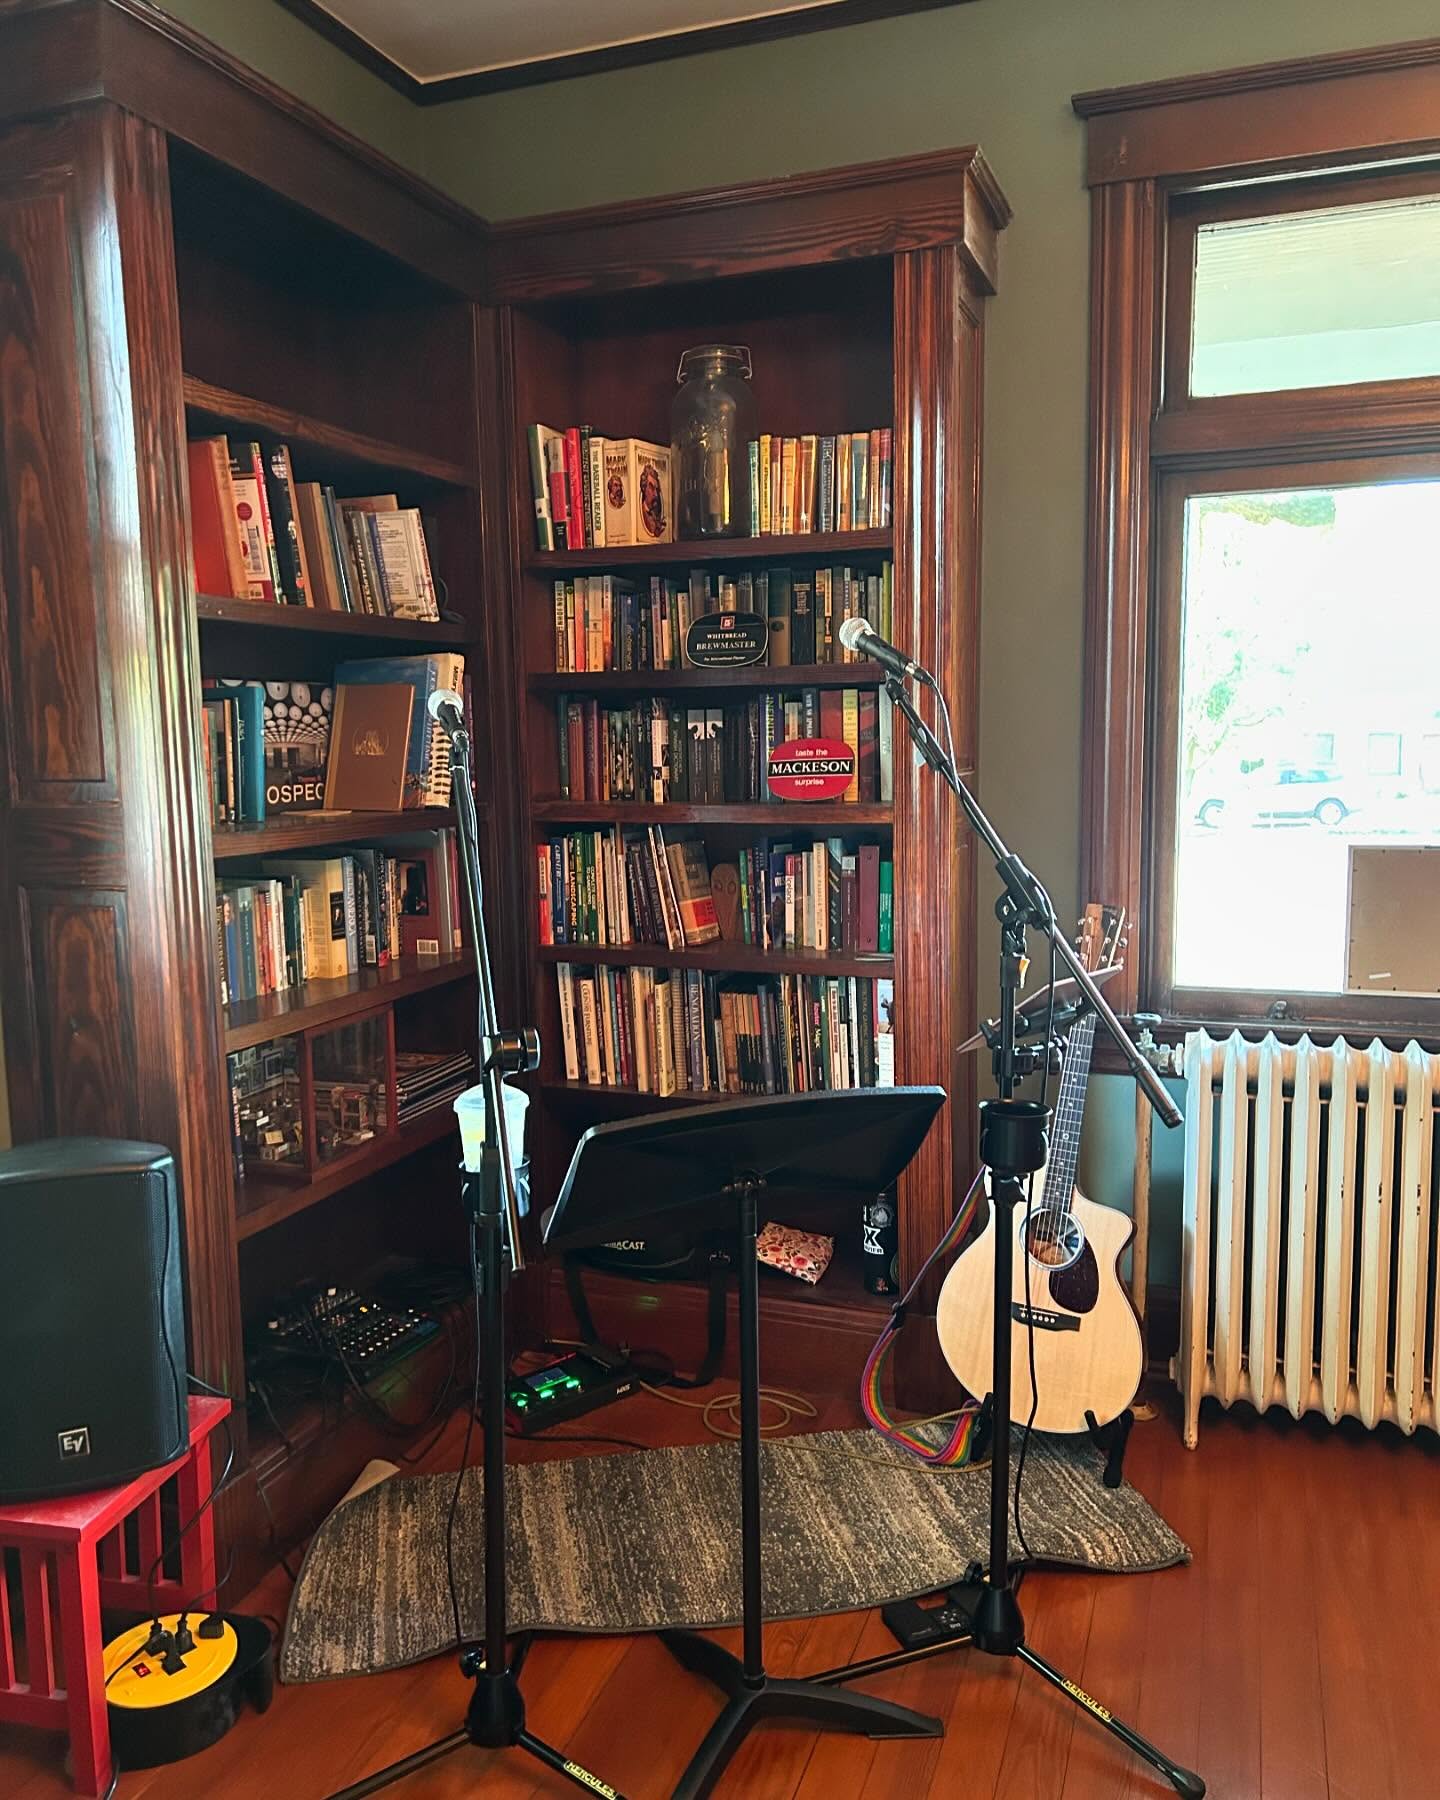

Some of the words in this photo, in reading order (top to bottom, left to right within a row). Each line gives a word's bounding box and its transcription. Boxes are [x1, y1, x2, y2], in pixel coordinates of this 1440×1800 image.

[606, 455, 627, 464] MARK
[706, 632, 748, 640] WHITBREAD
[696, 641, 757, 650] BREWMASTER
[767, 696, 775, 741] INFINITE
[795, 749, 814, 757] taste
[816, 748, 828, 756] the
[771, 760, 851, 775] MACKESON
[794, 778, 825, 787] surprise
[569, 871, 577, 927] LANDSCAPING
[346, 896, 356, 936] AMERICA
[690, 983, 700, 1041] RENOVATION
[63, 1435, 85, 1453] EV
[1063, 1679, 1111, 1719] HERCULES
[567, 1760, 616, 1799] HERCULES
